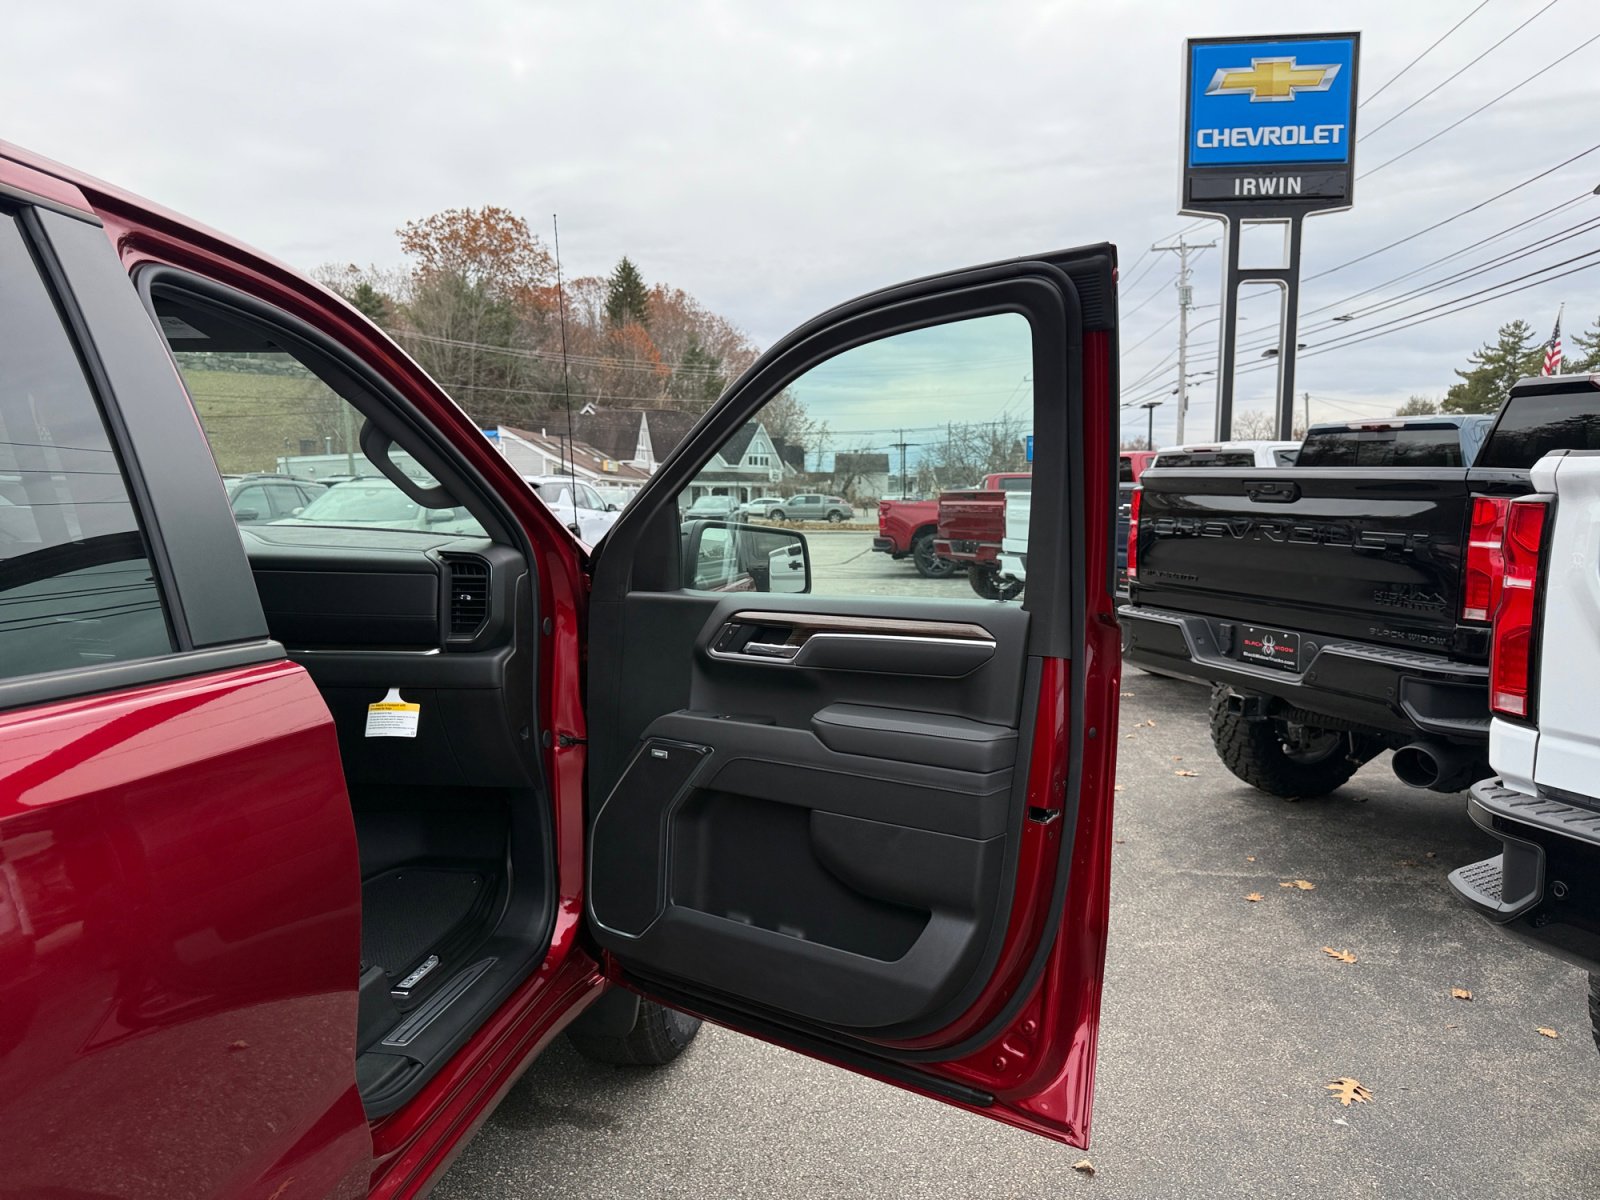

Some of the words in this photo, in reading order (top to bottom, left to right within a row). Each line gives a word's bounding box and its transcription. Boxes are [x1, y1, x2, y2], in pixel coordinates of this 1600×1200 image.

[1196, 124, 1345, 148] CHEVROLET
[1234, 176, 1302, 196] IRWIN
[1153, 517, 1430, 552] CHEVROLET
[1243, 639, 1264, 648] BLACK
[1273, 644, 1295, 653] WIDOW
[1368, 627, 1405, 639] BLACK
[1408, 632, 1447, 645] WIDOW
